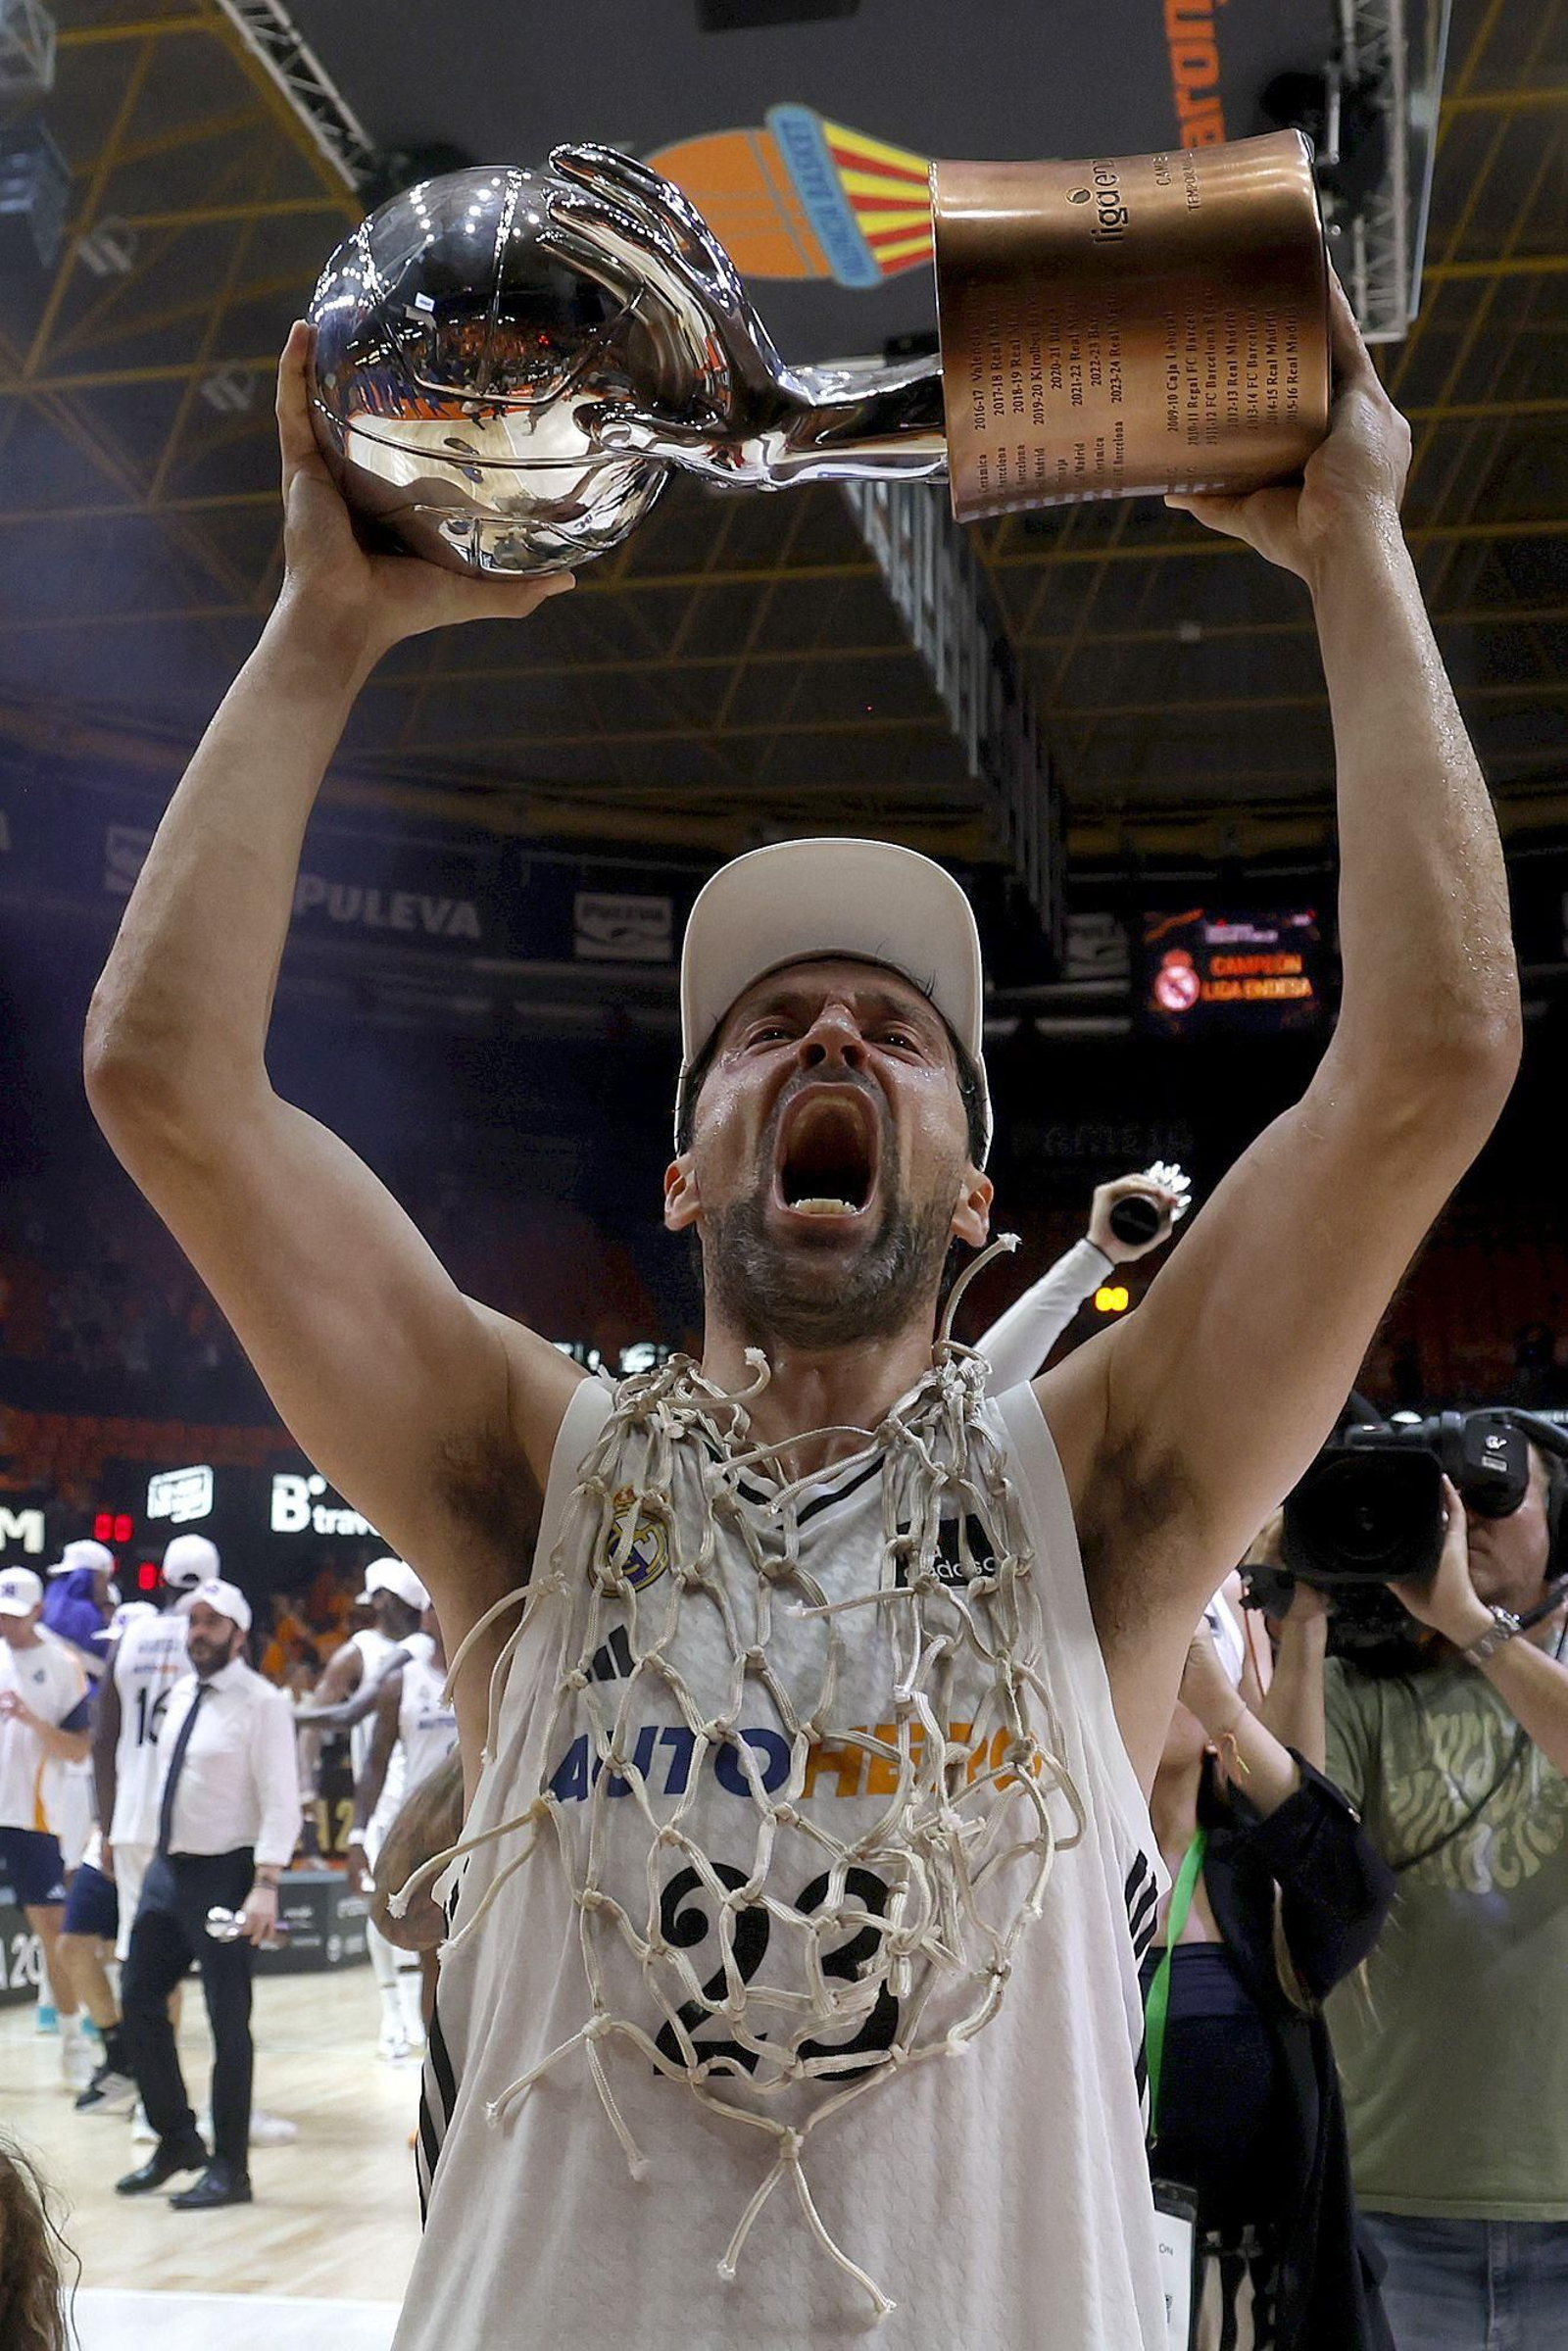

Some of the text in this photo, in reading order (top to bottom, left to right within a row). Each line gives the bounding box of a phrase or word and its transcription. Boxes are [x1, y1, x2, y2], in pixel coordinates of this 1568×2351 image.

[991, 374, 1005, 417] 2017-18
[1012, 370, 1025, 415] 2018-19
[1031, 383, 1046, 426] 2019-20
[1069, 364, 1084, 407] 2021-22
[1109, 360, 1123, 405] 2023-24
[972, 389, 987, 431] 2016-17
[296, 875, 482, 939] PULEVA
[549, 1721, 1043, 1803] AUTOHERO
[653, 1862, 900, 2082] 23
